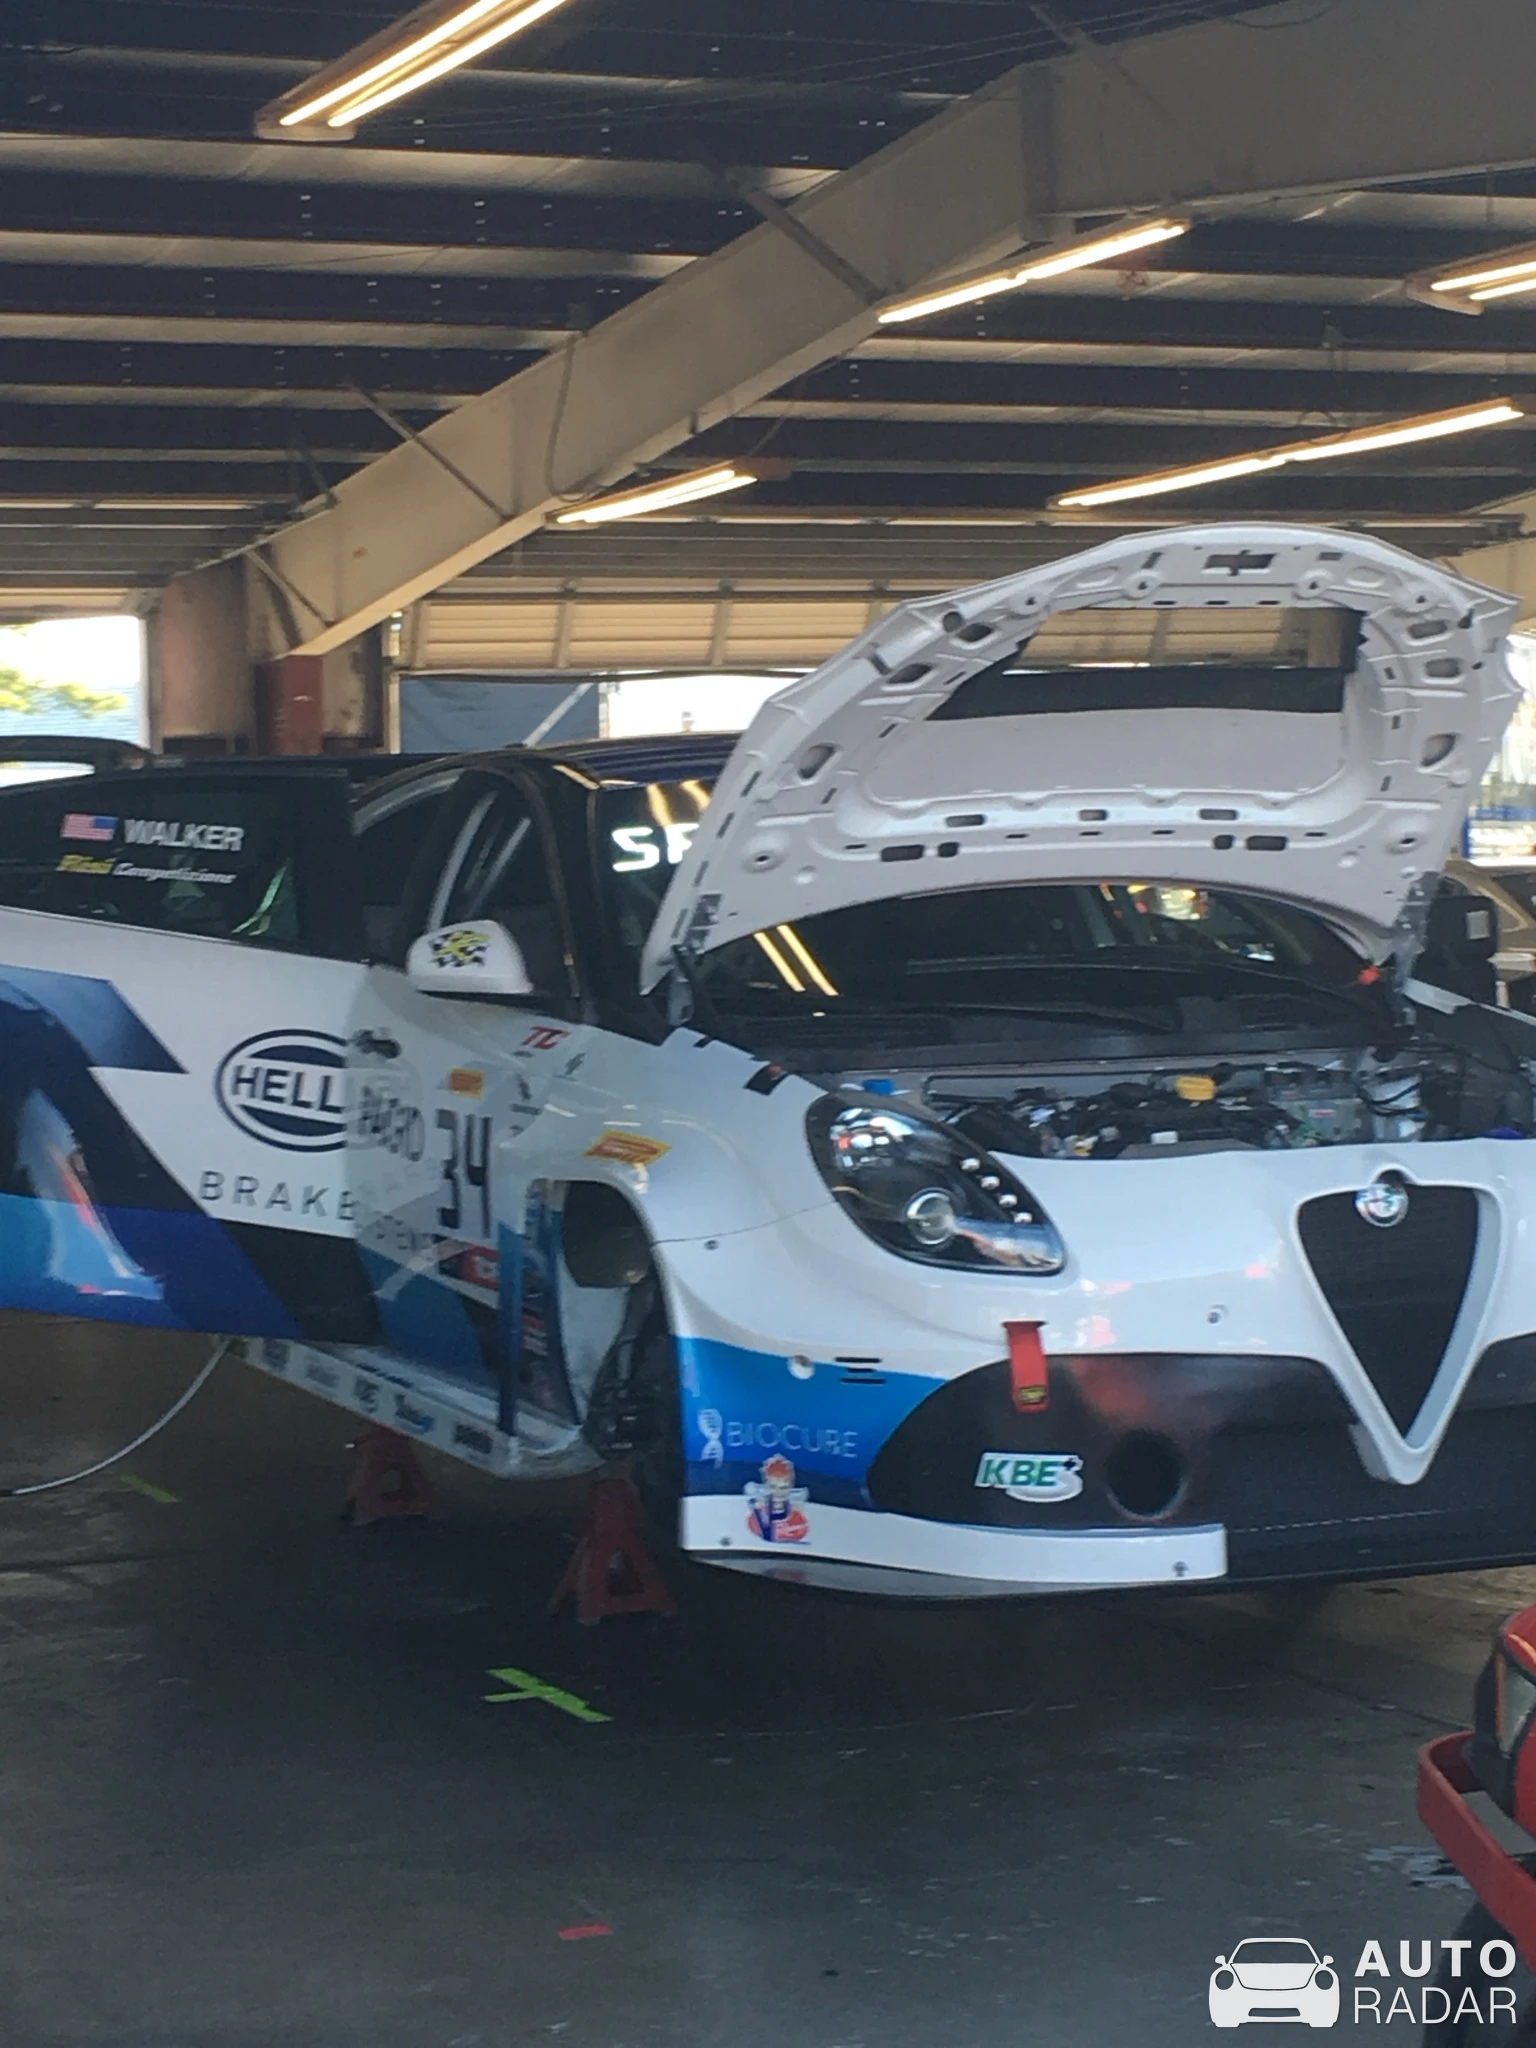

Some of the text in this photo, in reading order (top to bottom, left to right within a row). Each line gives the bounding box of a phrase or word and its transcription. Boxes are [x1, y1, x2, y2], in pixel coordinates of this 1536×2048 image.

[123, 819, 245, 851] WALKER
[231, 1064, 345, 1115] HELL
[436, 1109, 492, 1239] 34
[726, 1421, 858, 1459] BIOCURE
